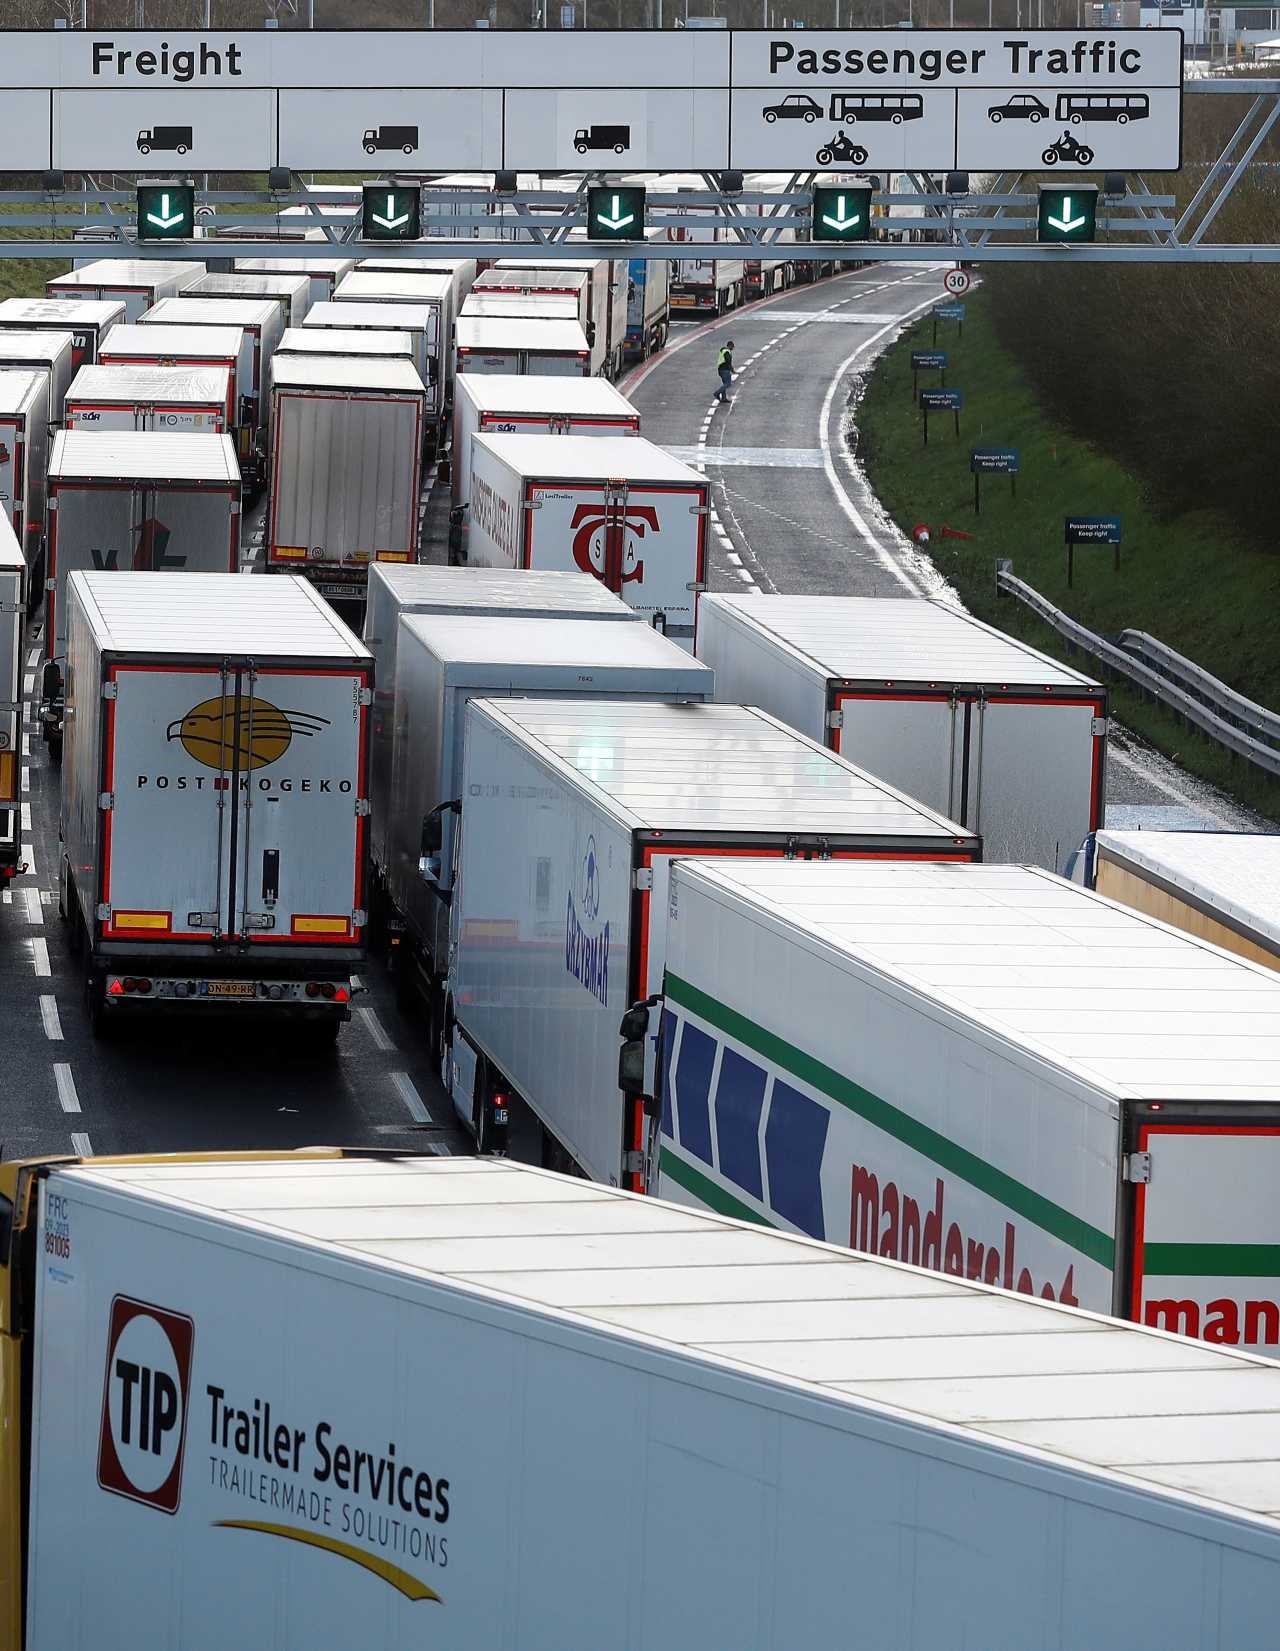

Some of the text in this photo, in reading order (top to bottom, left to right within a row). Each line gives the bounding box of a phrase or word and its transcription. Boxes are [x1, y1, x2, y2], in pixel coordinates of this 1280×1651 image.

[92, 42, 242, 82] Freight
[770, 40, 1142, 81] Passenger Traffic
[949, 276, 964, 287] 30
[1094, 530, 1108, 538] right
[137, 775, 352, 793] POST KOGEKO
[48, 1194, 68, 1220] FRC
[115, 1358, 178, 1456] TIP
[206, 1383, 450, 1524] Trailer Services
[209, 1455, 449, 1568] TRAILERMADE SOLUTIONS
